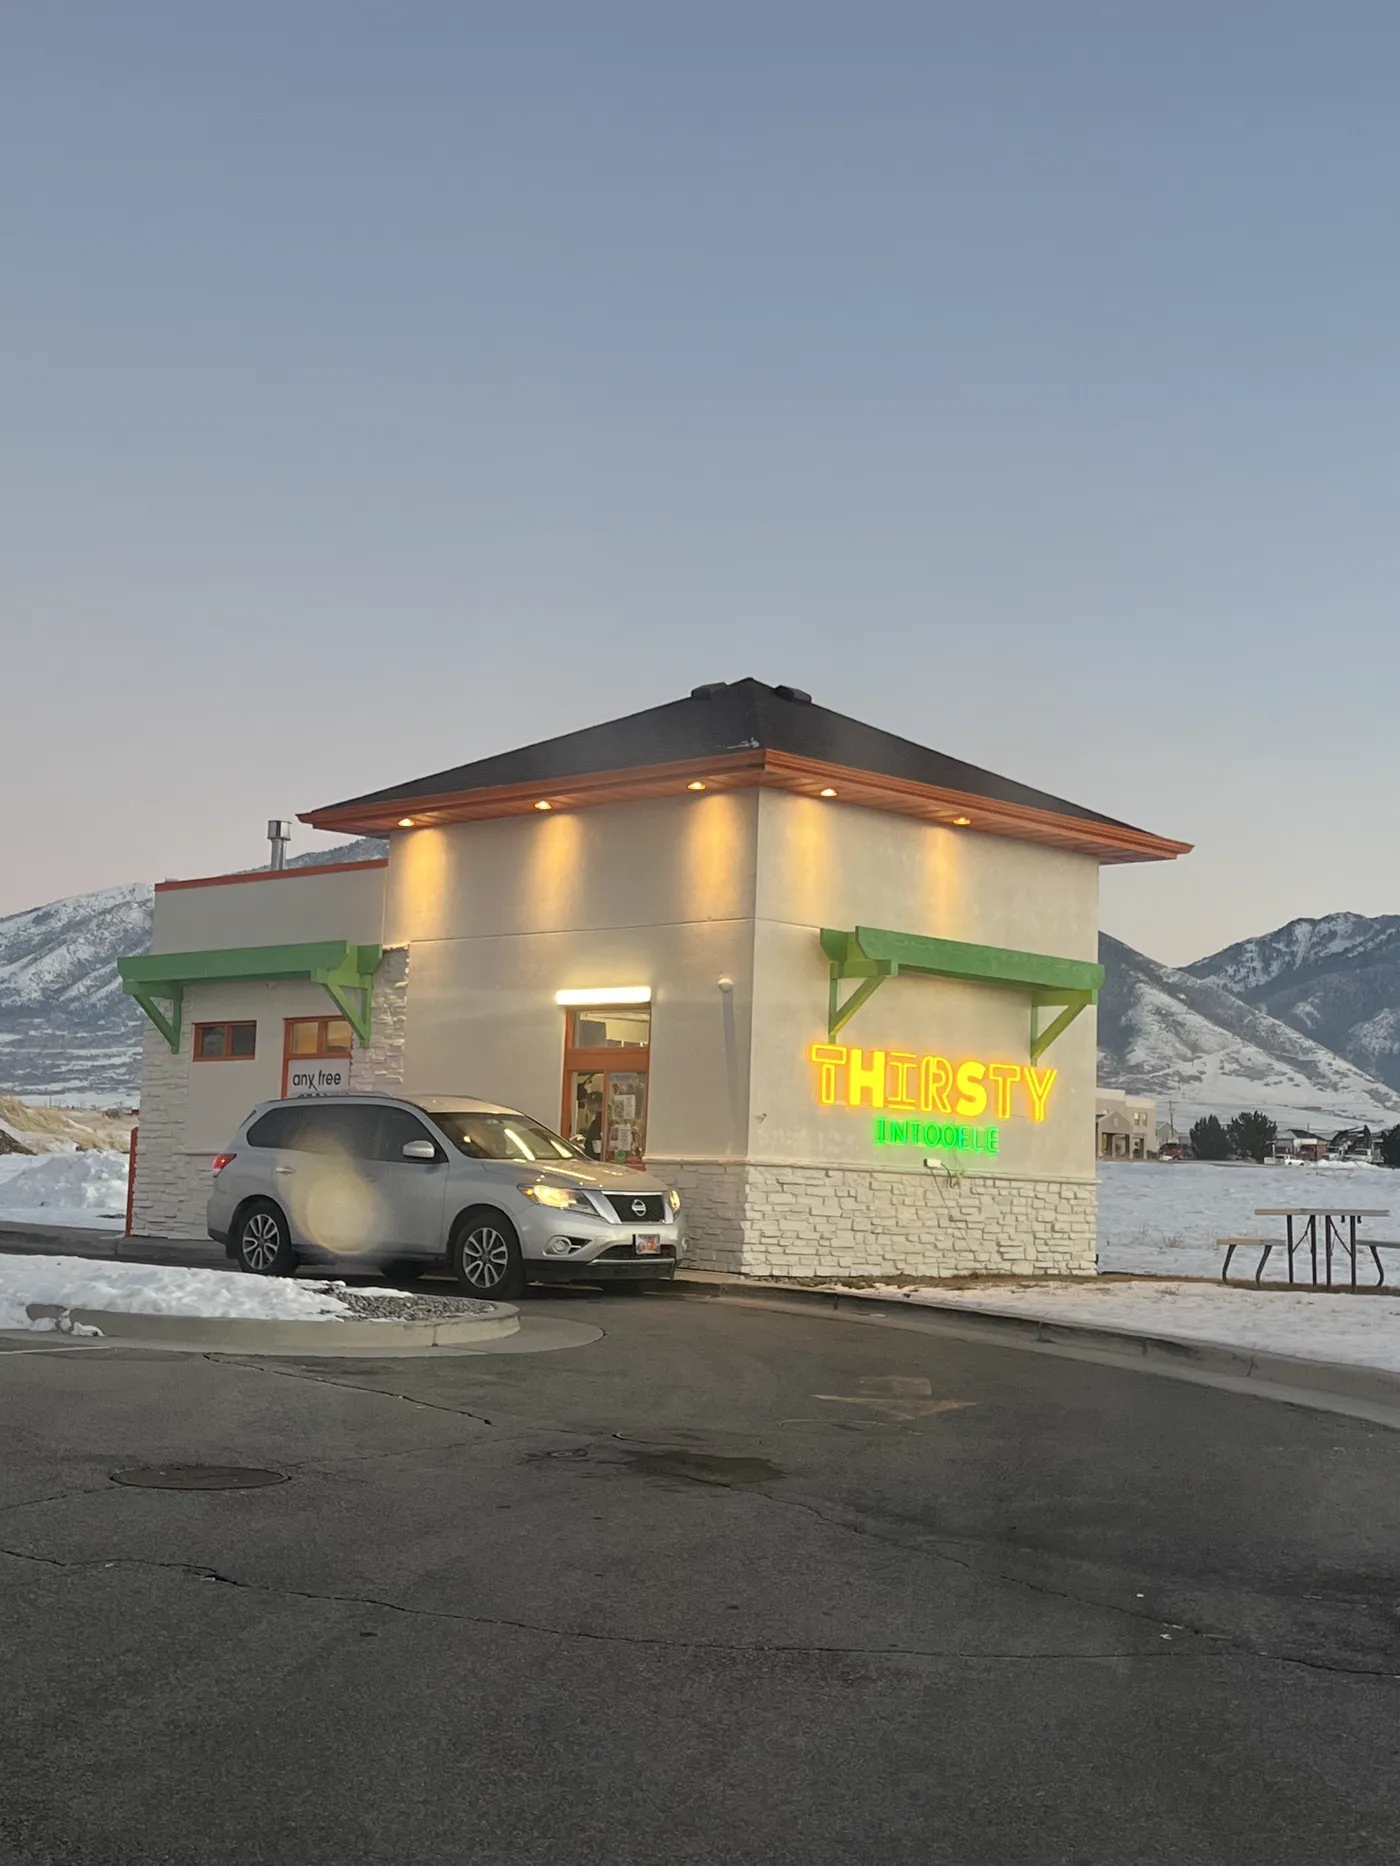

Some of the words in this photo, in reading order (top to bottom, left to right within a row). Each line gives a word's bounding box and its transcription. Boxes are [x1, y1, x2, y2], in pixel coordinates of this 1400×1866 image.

[292, 1073, 315, 1089] any
[318, 1070, 342, 1086] free
[811, 1043, 1057, 1122] THIRSTY
